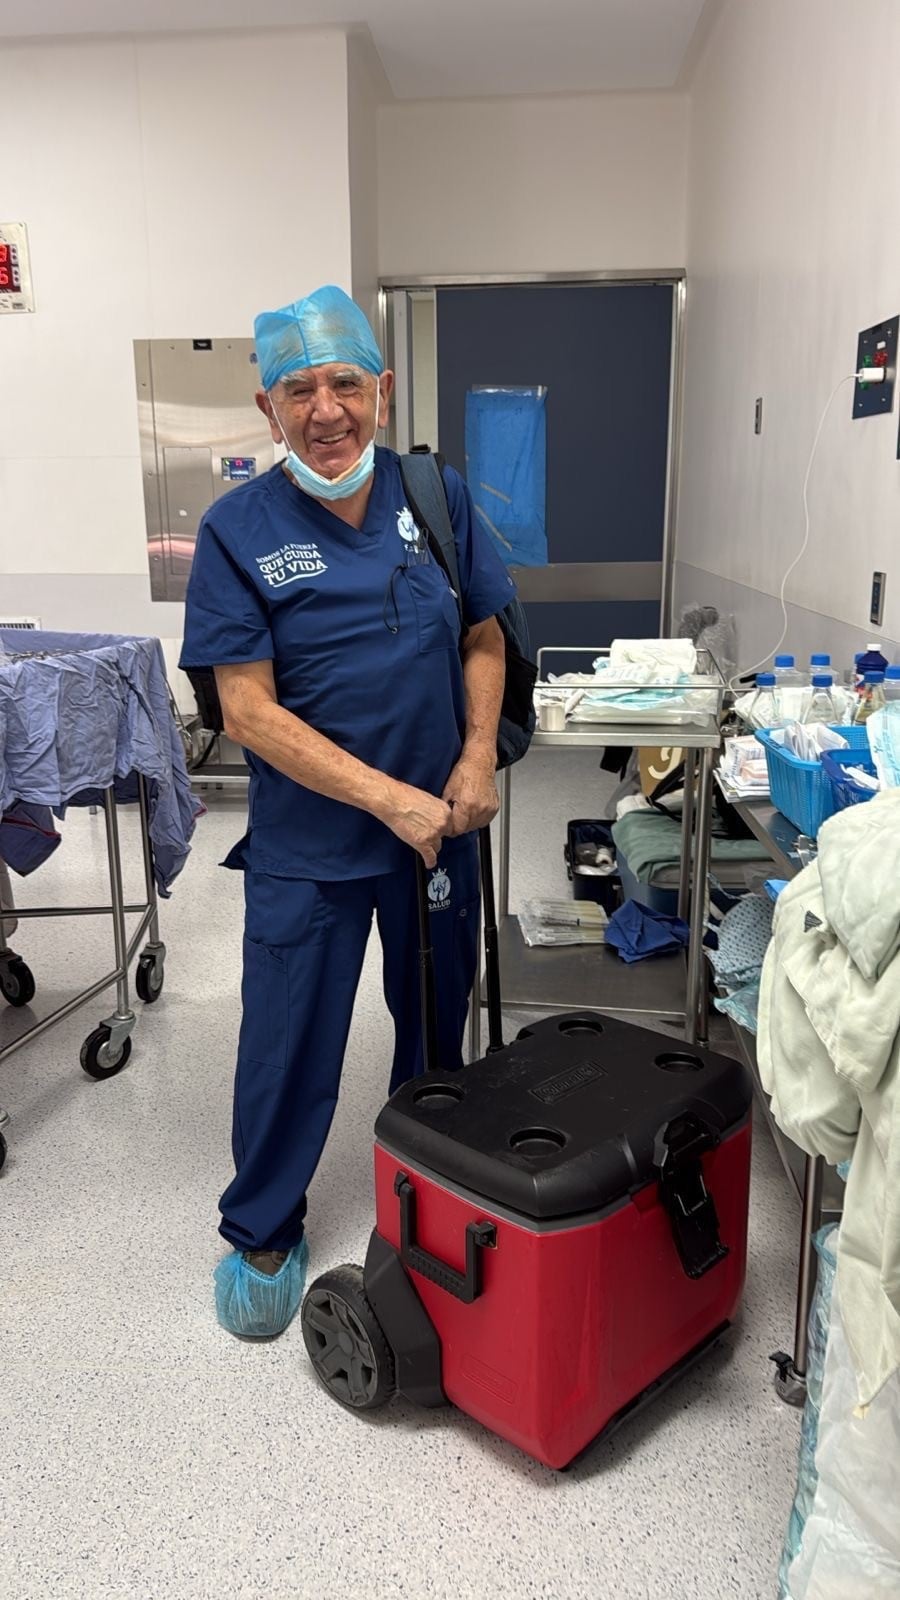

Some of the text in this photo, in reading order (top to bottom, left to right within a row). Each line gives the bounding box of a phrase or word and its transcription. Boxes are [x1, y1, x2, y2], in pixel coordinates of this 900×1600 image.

[255, 542, 318, 564] SOMOS LA FUERZA
[259, 550, 323, 574] QUE CUIDA
[263, 559, 329, 585] TU VIDA
[427, 898, 451, 910] SALUD
